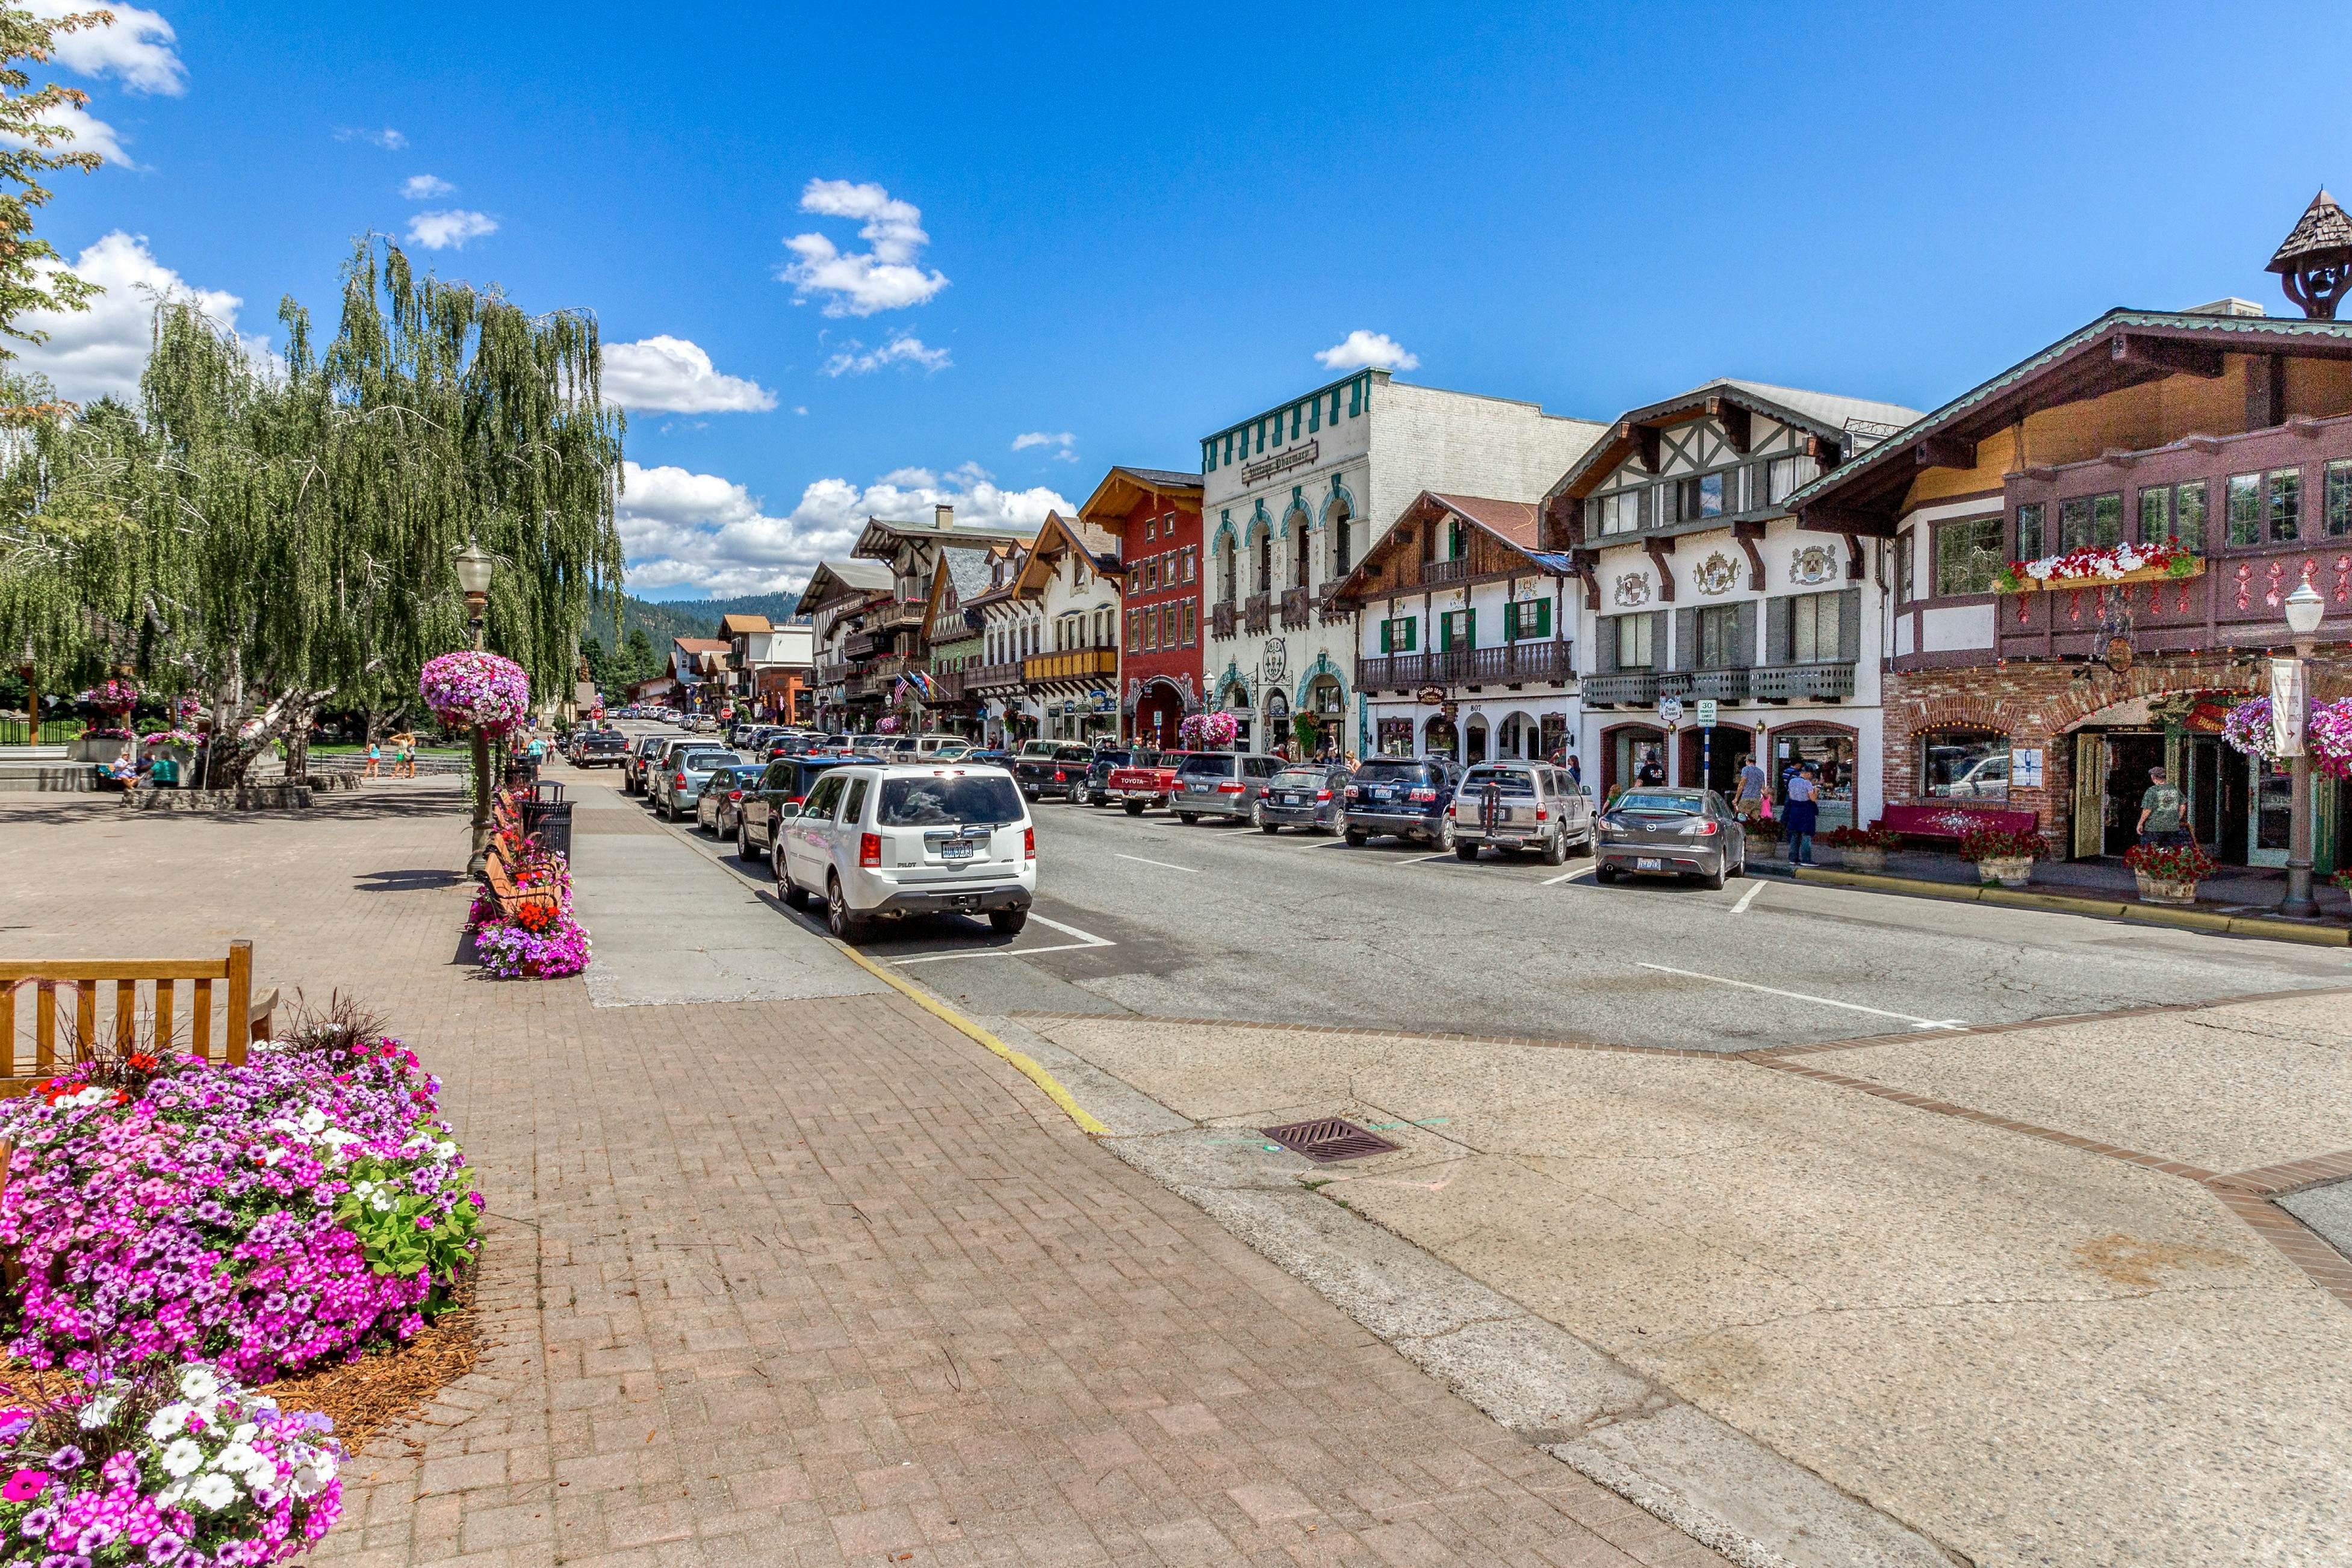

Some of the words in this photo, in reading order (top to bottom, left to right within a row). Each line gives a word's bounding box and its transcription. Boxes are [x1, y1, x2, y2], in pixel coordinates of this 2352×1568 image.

[1276, 450, 1309, 471] Pharmacy
[1418, 686, 1433, 697] Studio
[2198, 717, 2225, 731] Bistro
[944, 846, 971, 855] AUK3213
